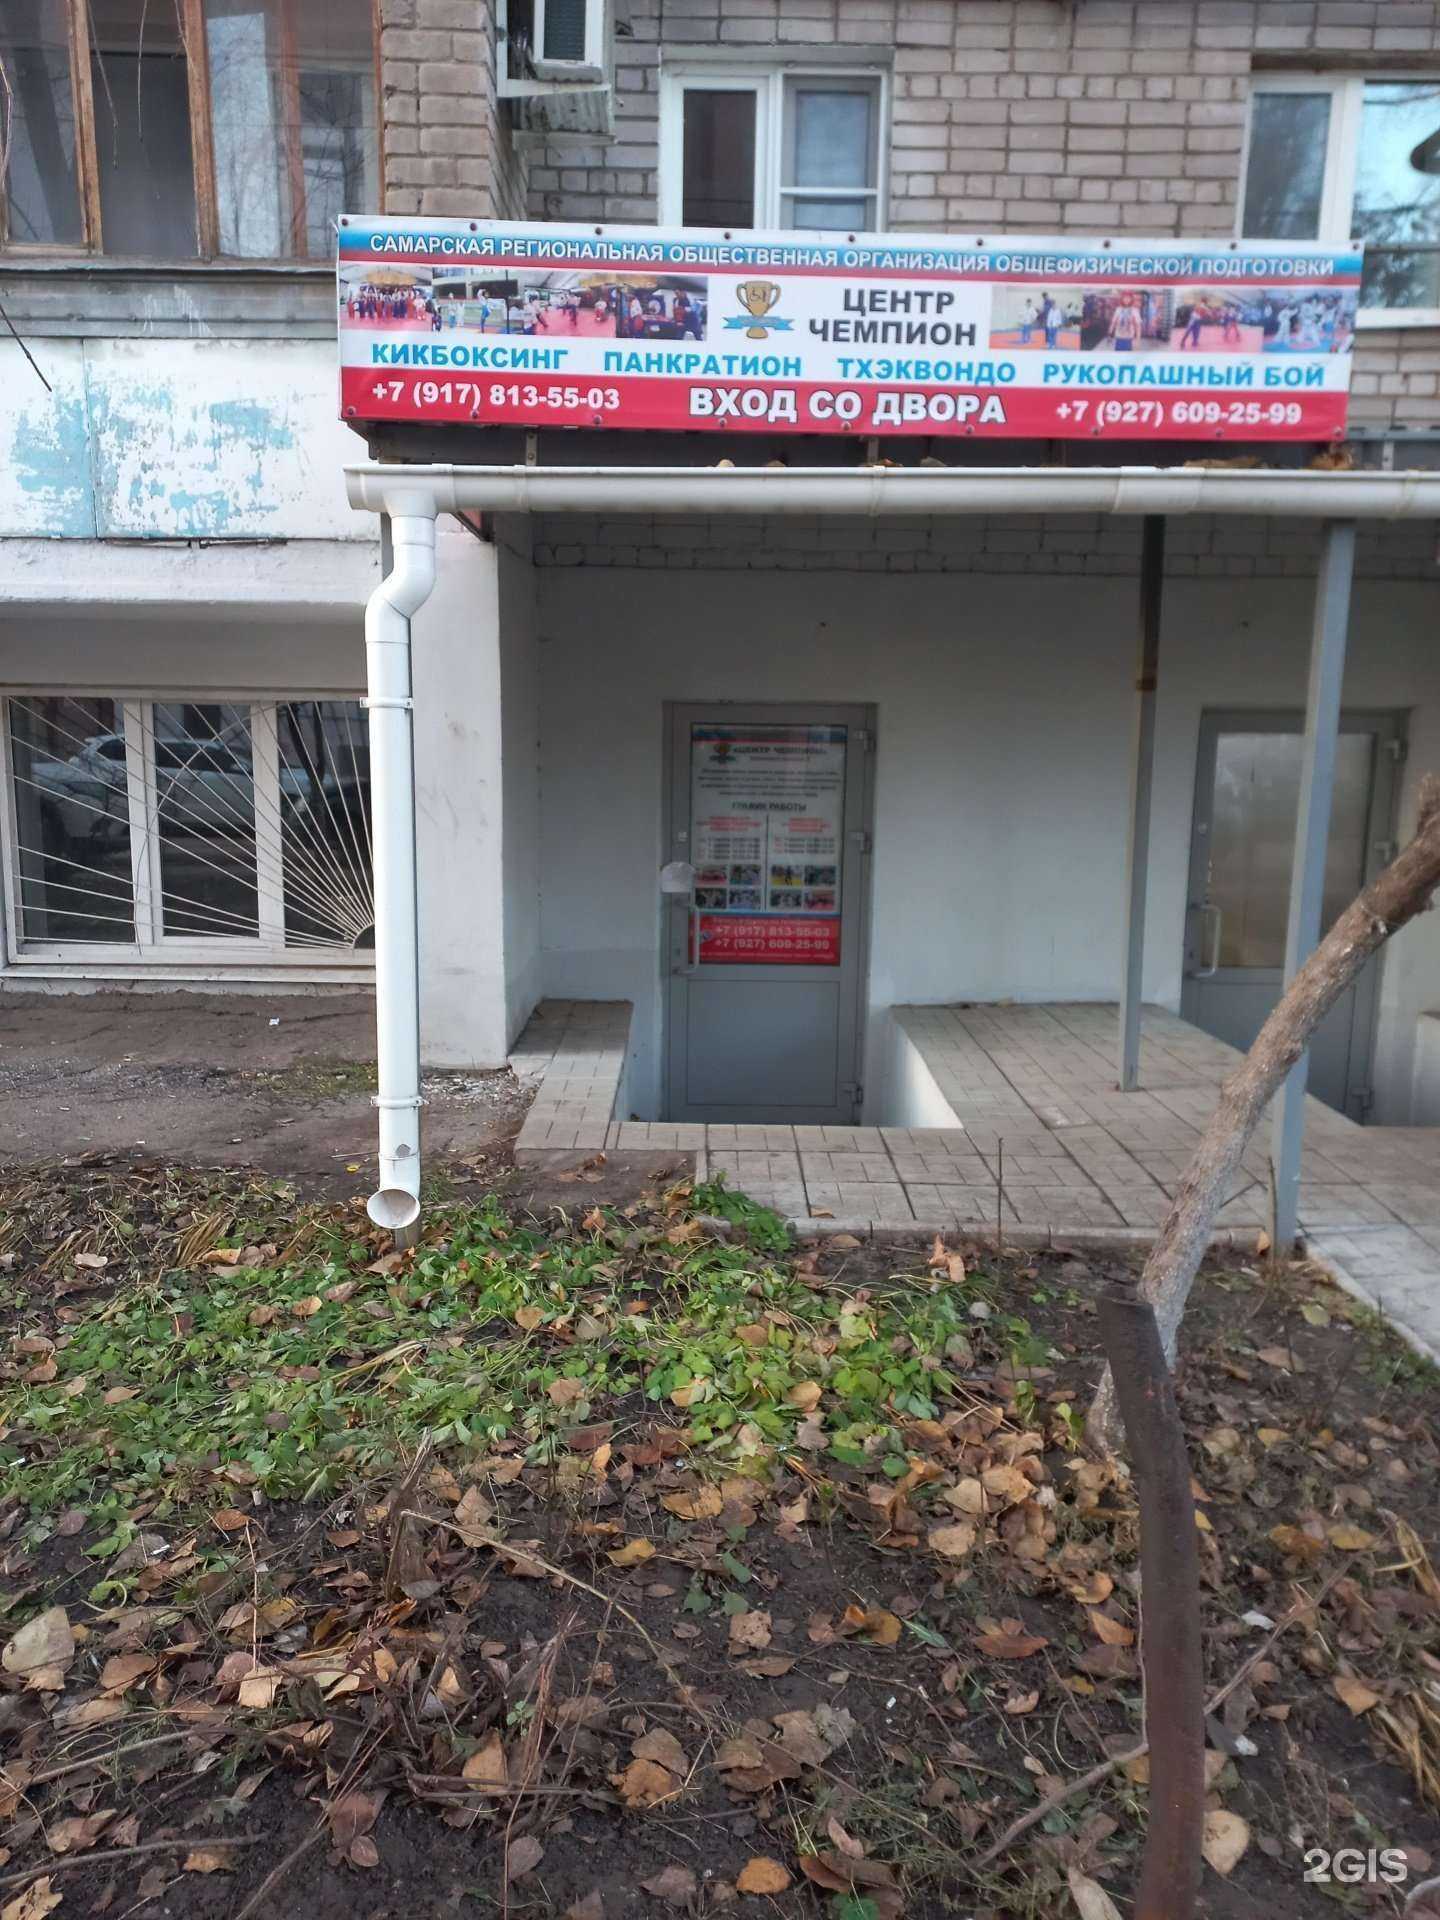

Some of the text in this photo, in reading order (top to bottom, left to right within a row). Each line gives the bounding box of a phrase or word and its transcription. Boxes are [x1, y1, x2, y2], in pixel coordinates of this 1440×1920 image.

[369, 233, 1335, 279] САМАРСКАЯ РЕГИОНАЛЬНАЯ ОБЩЕСТВЕННАЯ ОРГАНИЗАЦИЯ ОБЩЕФИЗИЧЕСКОЙ ПОДГОТОВКИ
[843, 288, 956, 317] ЦЕНТР
[808, 318, 977, 347] ЧЕМПИОН
[371, 343, 1325, 388] КИКБОКСИНГ ПАНКРАТИОН ТХЭКВОНДО РУКОПАШНЫЙ БОЙ
[371, 380, 621, 411] +7 (917) 813-55-03
[688, 386, 1008, 427] ВХОД СО ДВОРА
[1055, 400, 1304, 428] +7 (927) 609-25-99
